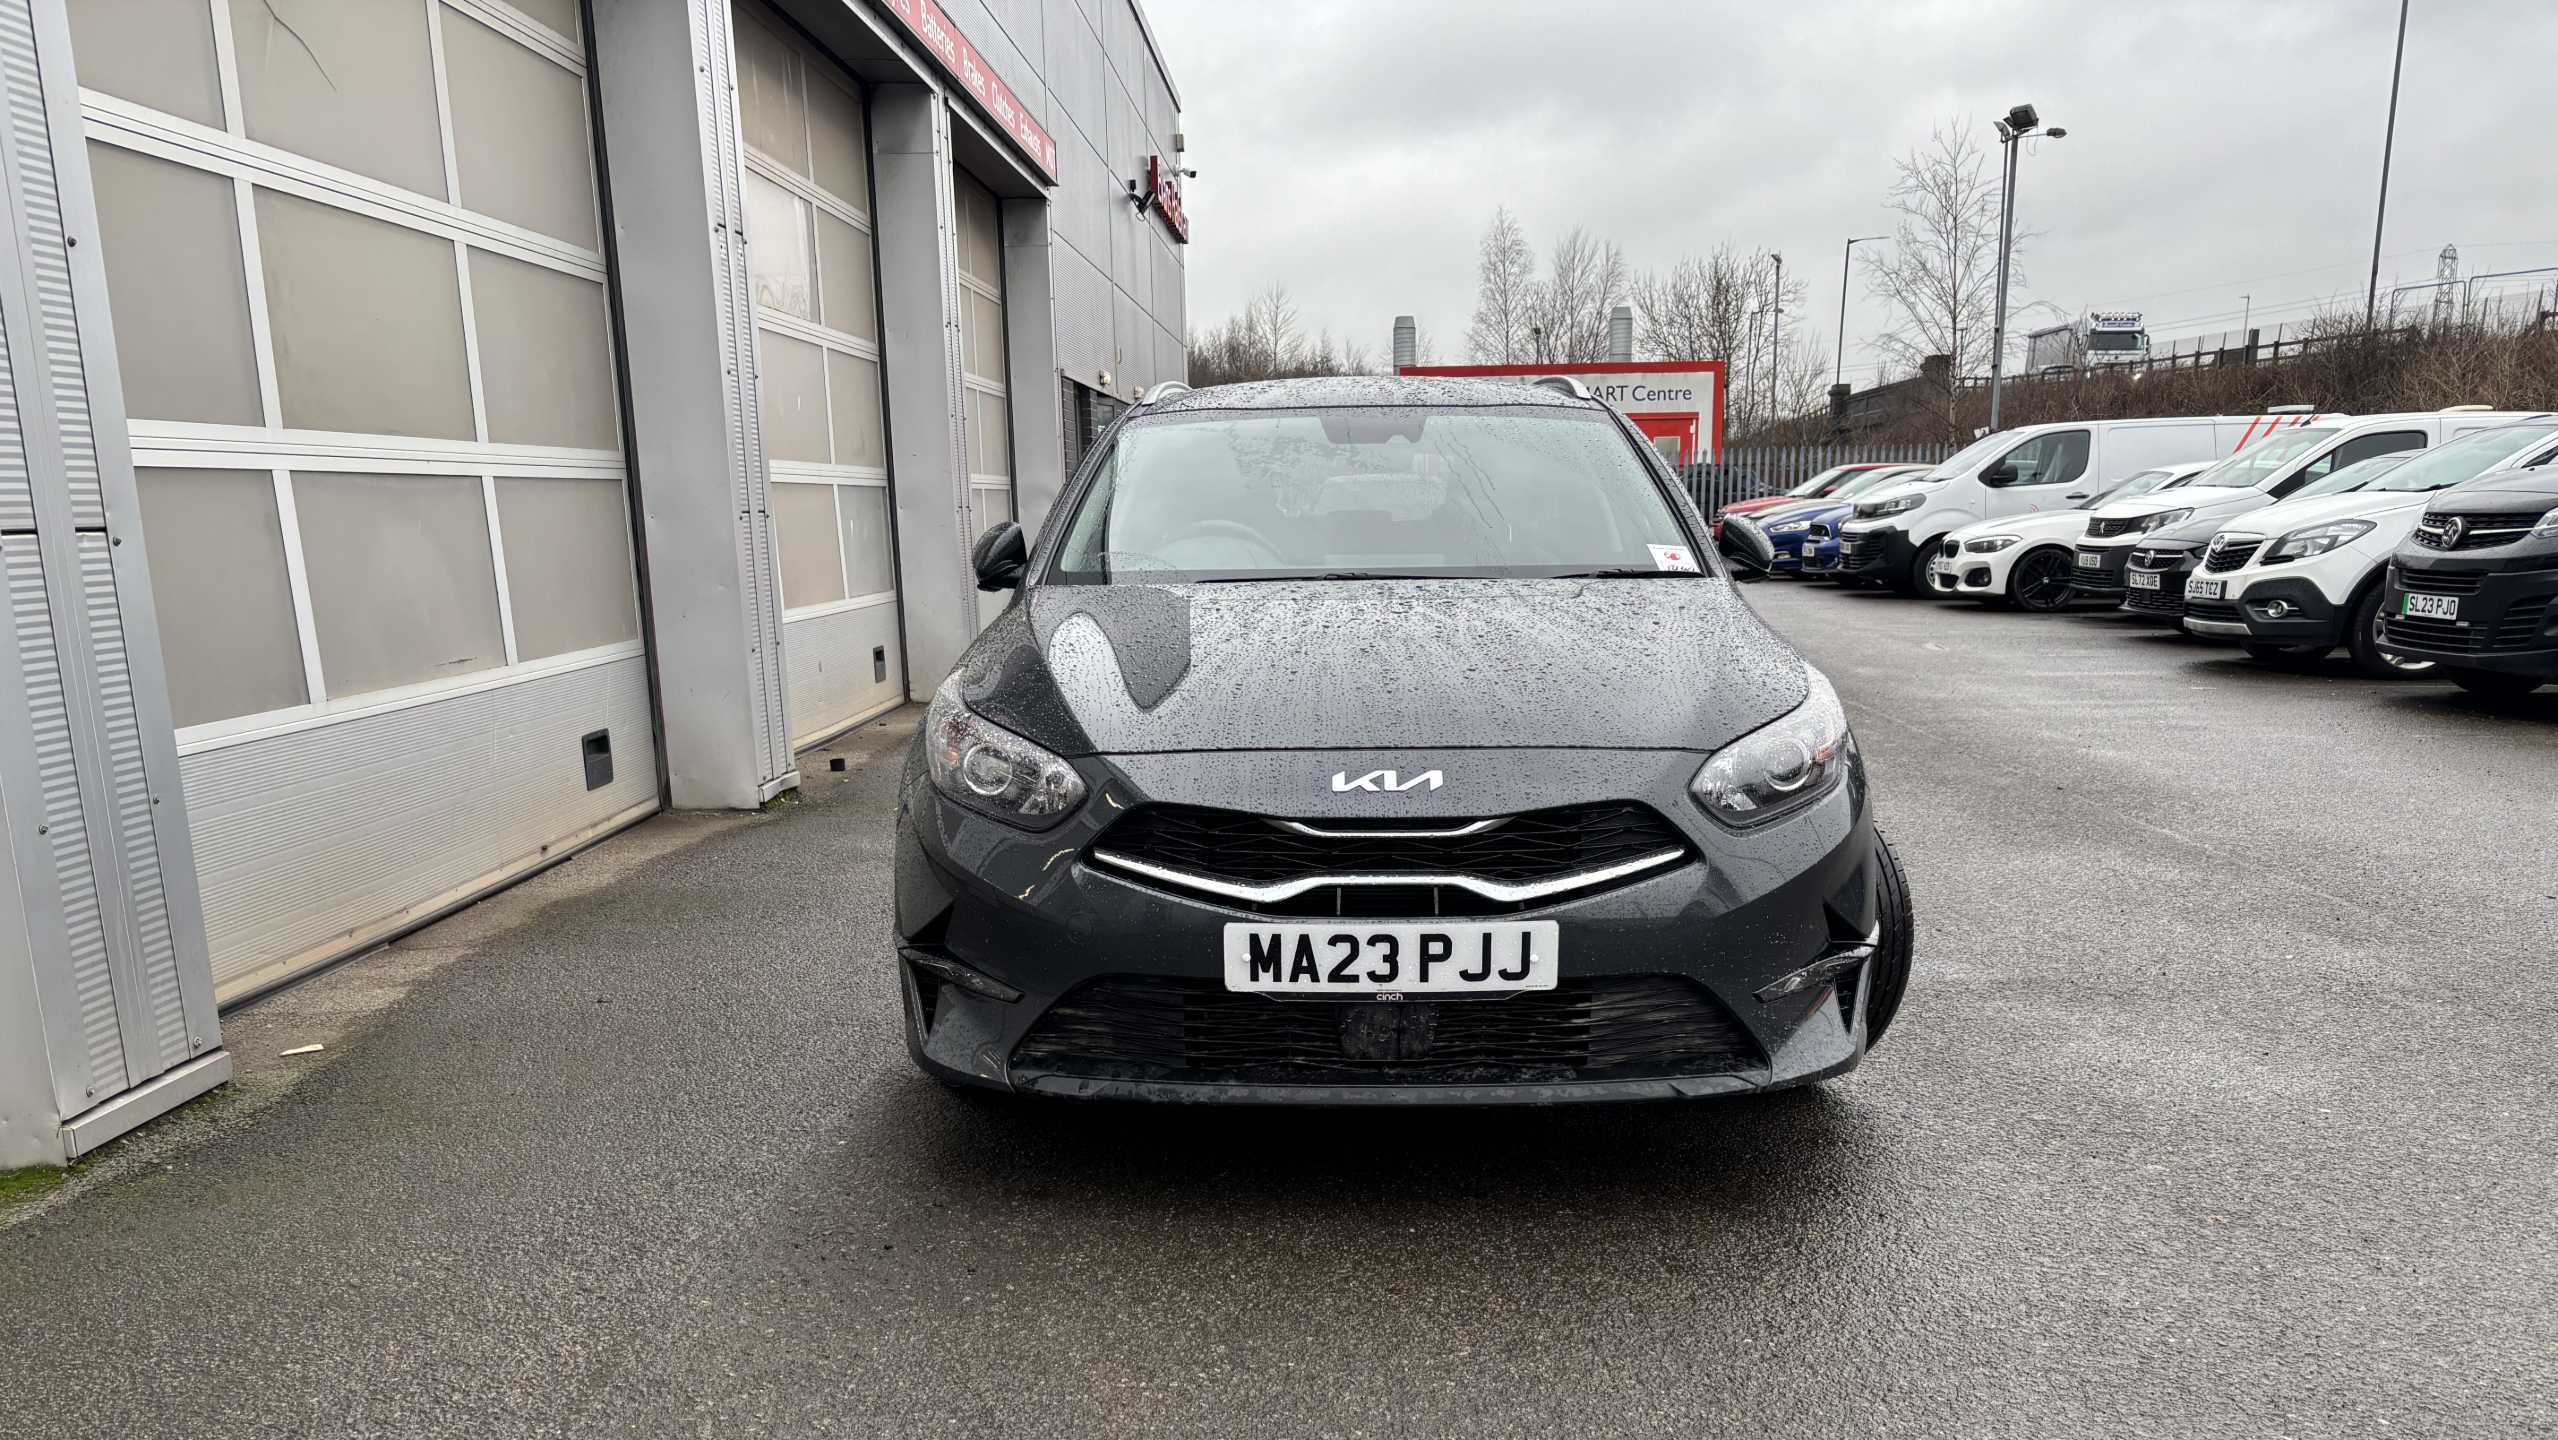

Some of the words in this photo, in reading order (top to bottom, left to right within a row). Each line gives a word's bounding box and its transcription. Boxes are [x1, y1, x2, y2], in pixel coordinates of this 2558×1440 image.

[920, 0, 956, 65] Batteries
[962, 47, 986, 97] Brakes
[1632, 385, 1693, 401] Centre
[2409, 595, 2435, 614] SL23
[1249, 933, 1400, 984] MA23
[1419, 931, 1532, 983] PJJ
[1376, 992, 1404, 1001] cinch
